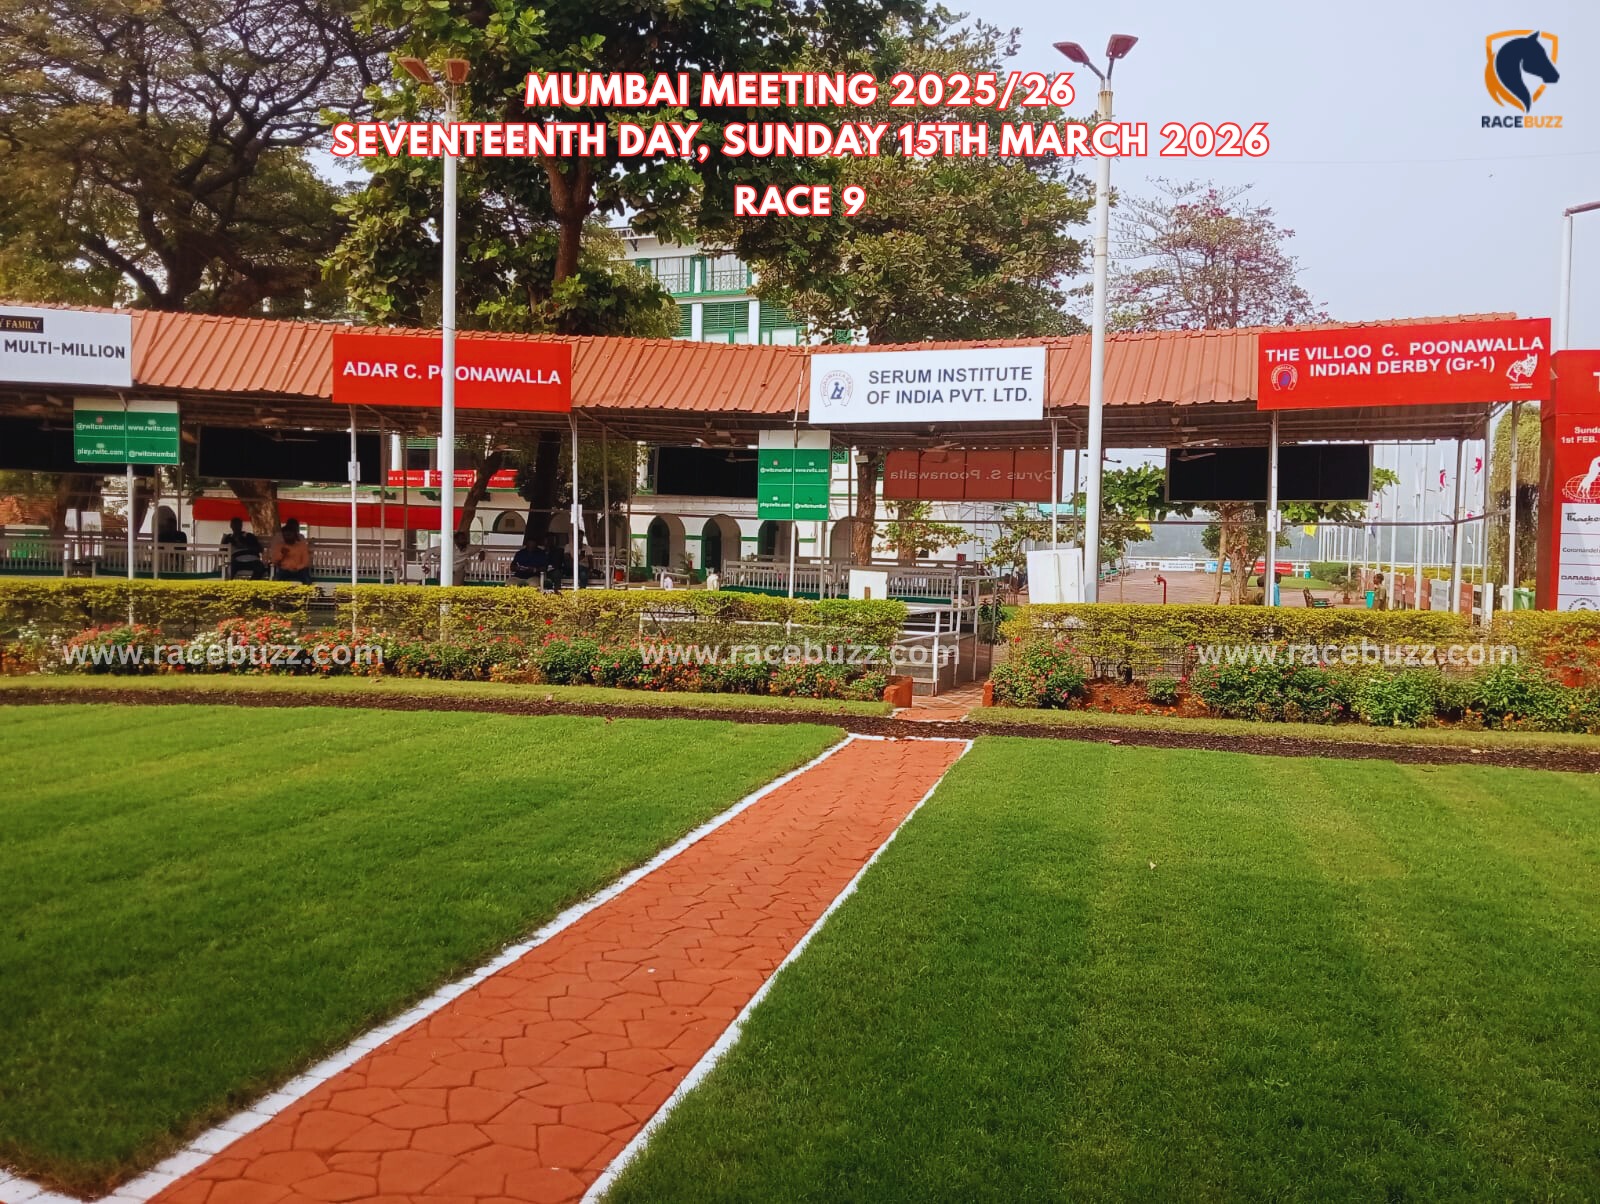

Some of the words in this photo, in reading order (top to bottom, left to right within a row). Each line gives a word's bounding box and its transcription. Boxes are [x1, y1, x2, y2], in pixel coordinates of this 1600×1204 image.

[6, 320, 40, 330] FAMILY
[4, 339, 125, 359] MULTI-MILLION
[1265, 348, 1300, 362] THE
[1305, 344, 1372, 361] VILLOO
[1381, 343, 1399, 357] C.
[1409, 336, 1544, 356] POONAWALLA
[343, 361, 399, 378] ADAR
[403, 364, 422, 379] C.
[428, 365, 562, 385] PONAWALLA
[868, 368, 932, 385] SERUM
[938, 366, 1033, 382] INSTITUTE
[1310, 361, 1371, 377] INDIAN
[1377, 358, 1440, 374] DERBY
[1446, 356, 1495, 375] (Gr-1)
[866, 390, 891, 405] OF
[896, 389, 944, 404] INDIA
[949, 388, 987, 403] PVT.
[993, 387, 1032, 402] LTD.
